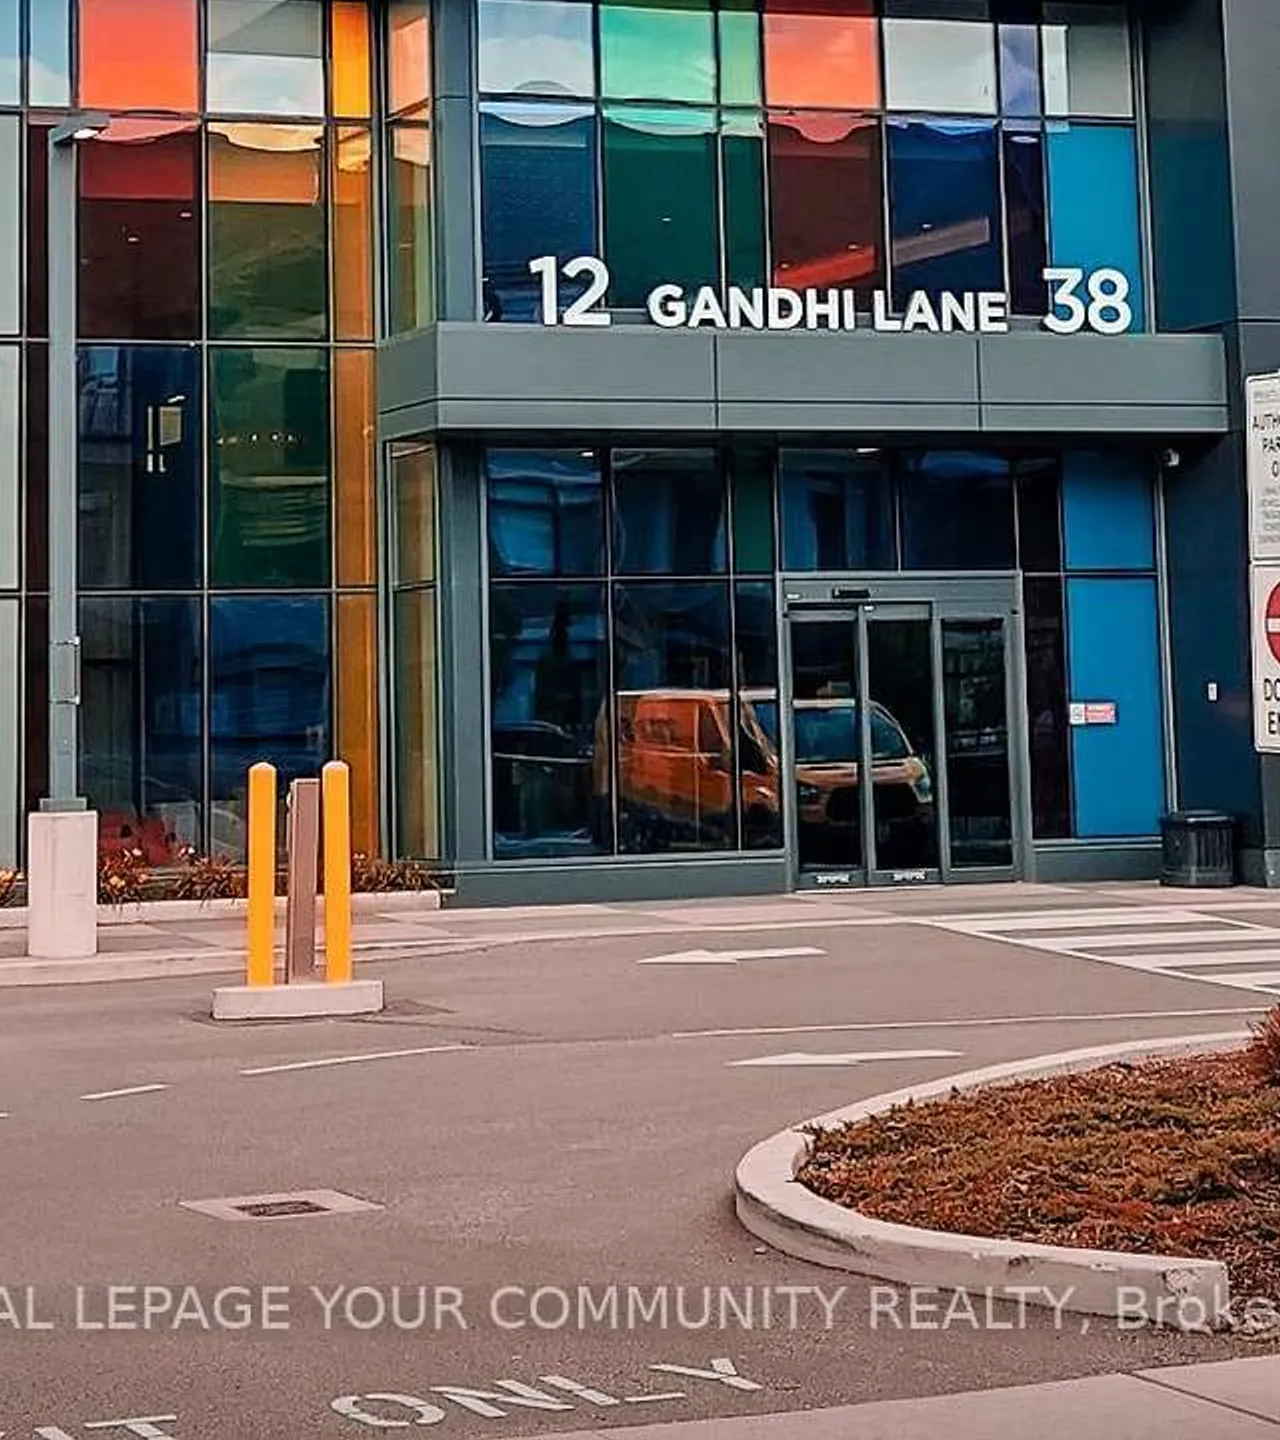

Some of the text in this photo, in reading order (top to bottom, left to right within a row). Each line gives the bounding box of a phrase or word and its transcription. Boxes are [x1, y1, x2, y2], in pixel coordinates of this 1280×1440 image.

[528, 255, 1133, 335] 12 GANDHI LANE 38
[330, 1357, 764, 1428] ONLY
